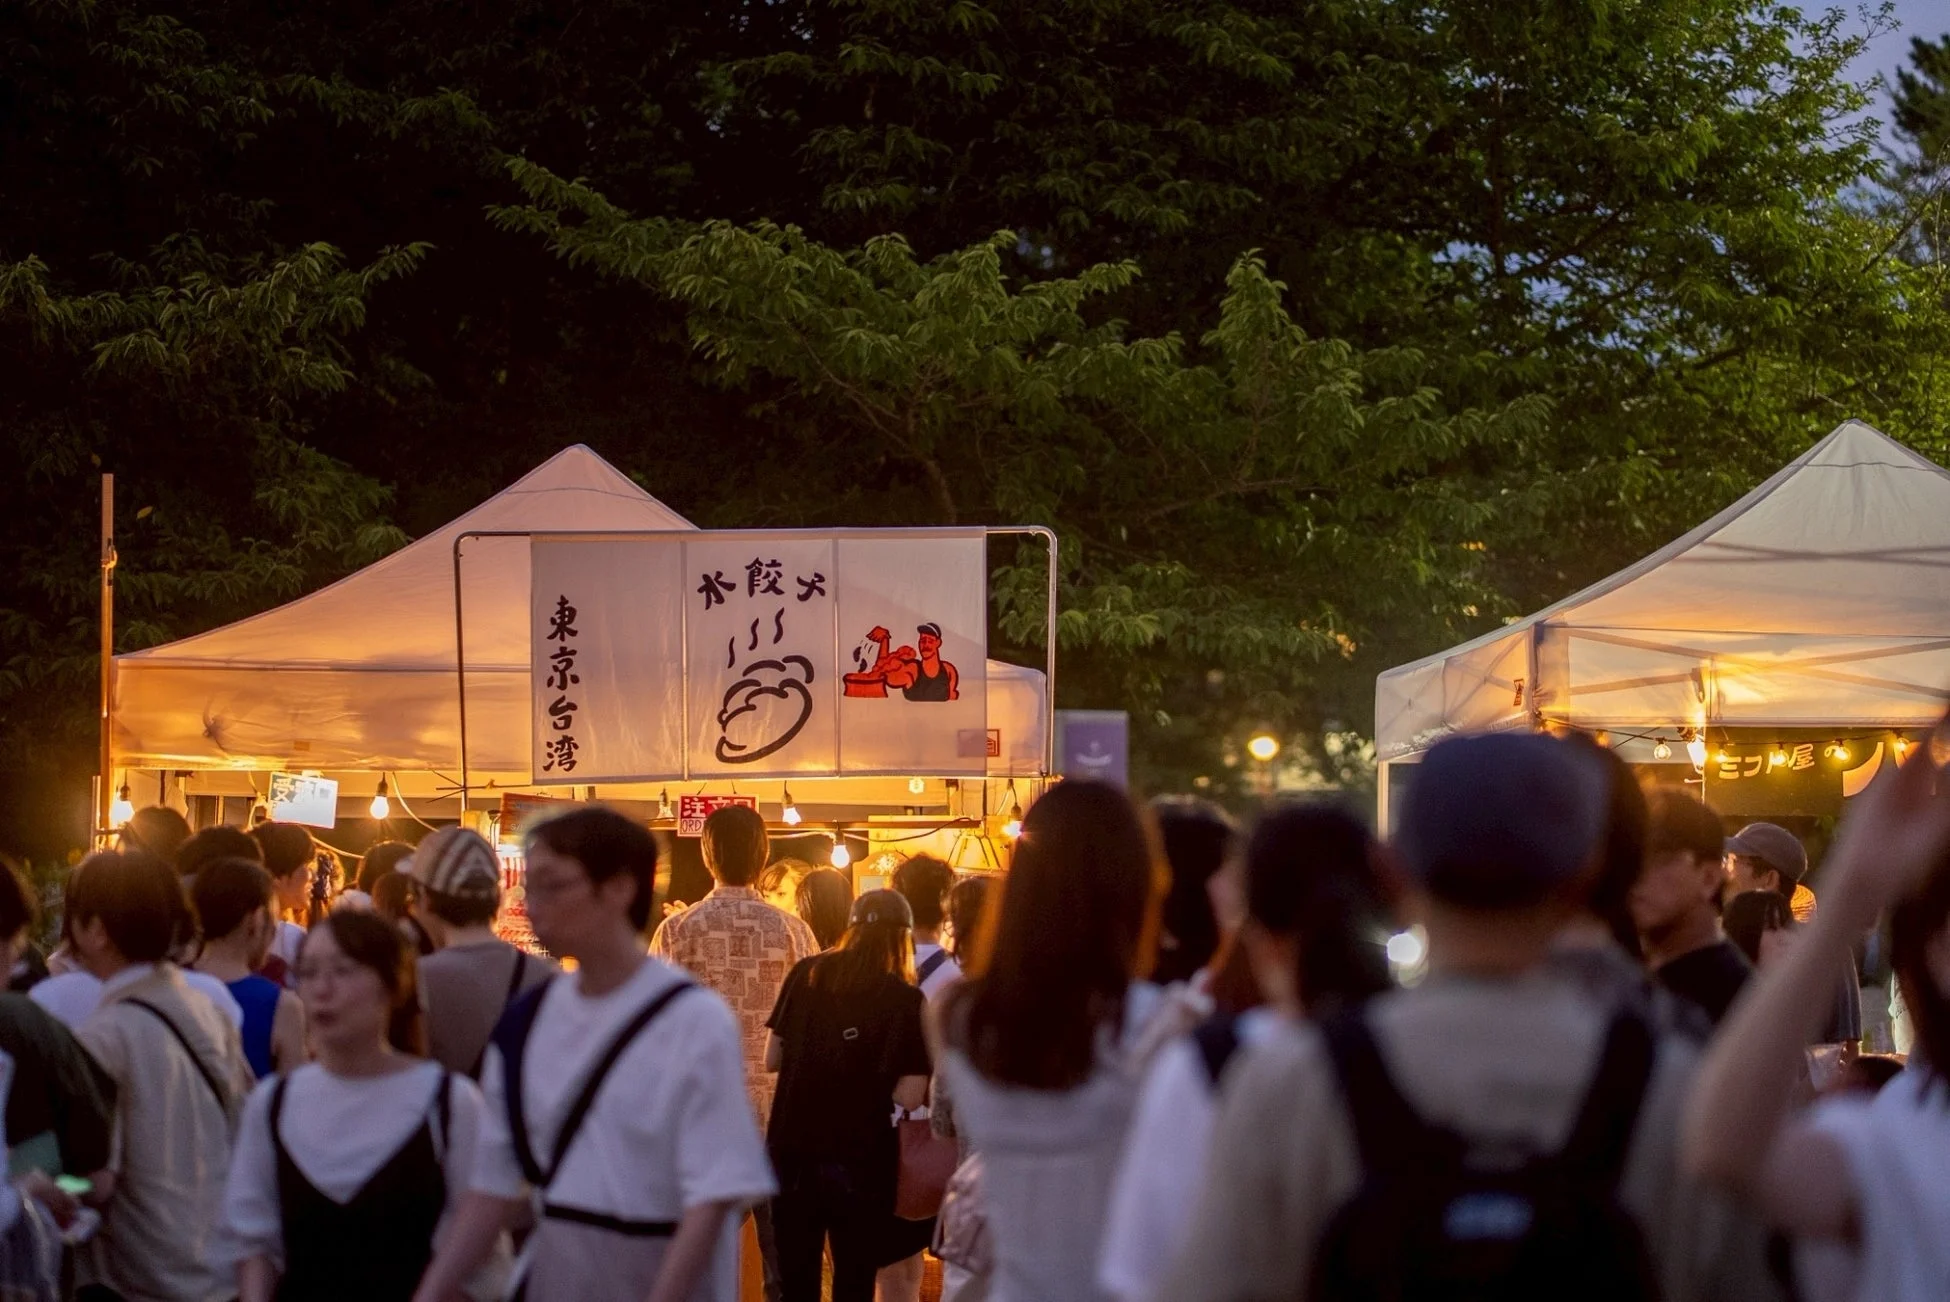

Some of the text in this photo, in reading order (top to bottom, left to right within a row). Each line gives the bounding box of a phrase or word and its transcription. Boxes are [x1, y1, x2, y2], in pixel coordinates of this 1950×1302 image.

[697, 557, 826, 610] 水餃子
[542, 594, 580, 772] 東京台湾
[682, 819, 702, 832] ORD
